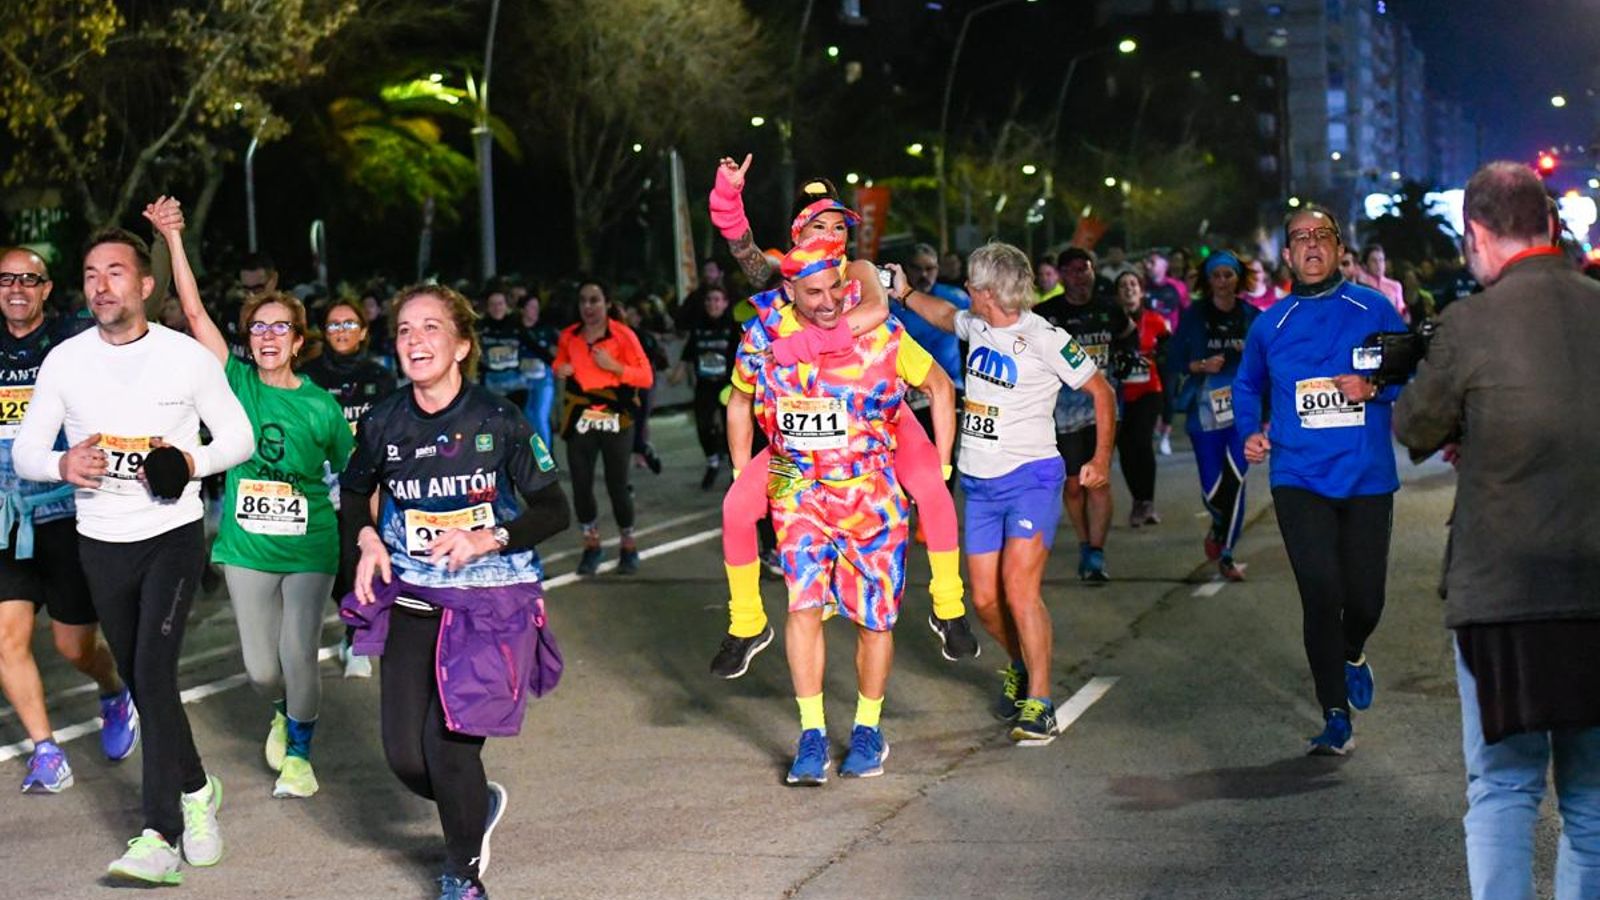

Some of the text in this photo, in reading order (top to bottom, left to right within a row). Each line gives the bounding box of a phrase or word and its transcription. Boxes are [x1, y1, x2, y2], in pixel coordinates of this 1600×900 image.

[1302, 390, 1360, 411] 800
[783, 412, 838, 431] 8711
[388, 467, 497, 501] SAN ANTÓN
[242, 495, 302, 516] 8654
